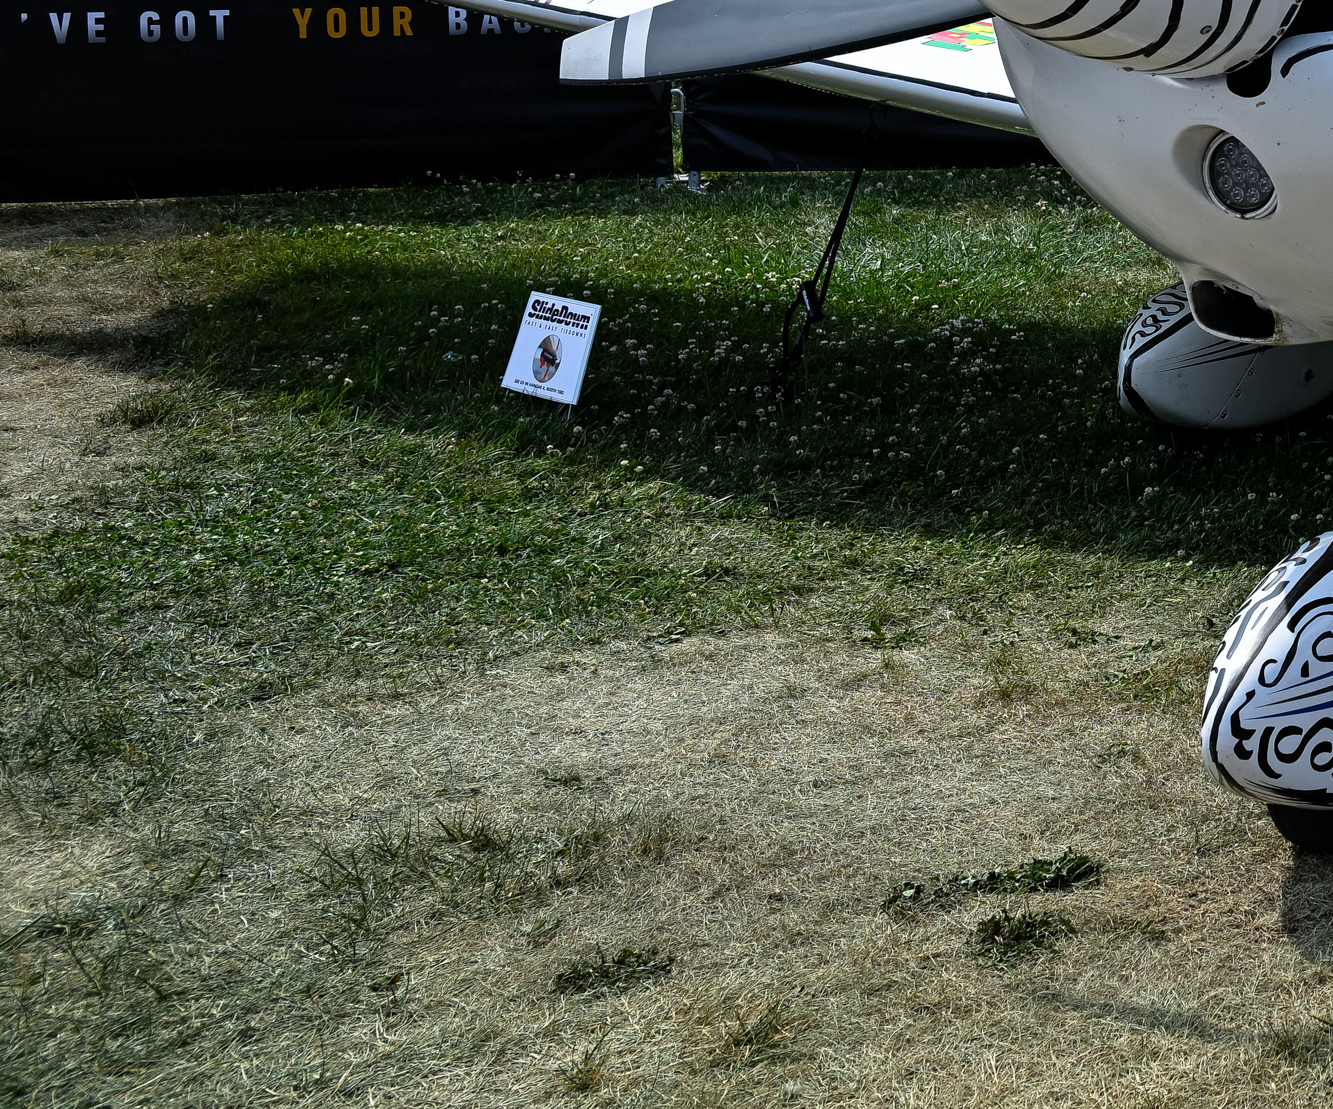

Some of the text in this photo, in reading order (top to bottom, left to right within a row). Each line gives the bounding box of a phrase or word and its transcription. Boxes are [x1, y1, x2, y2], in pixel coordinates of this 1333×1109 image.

[139, 10, 231, 43] GOT
[292, 5, 414, 39] YOUR
[527, 298, 591, 331] SlideDown
[560, 327, 587, 339] TIEDOWNS
